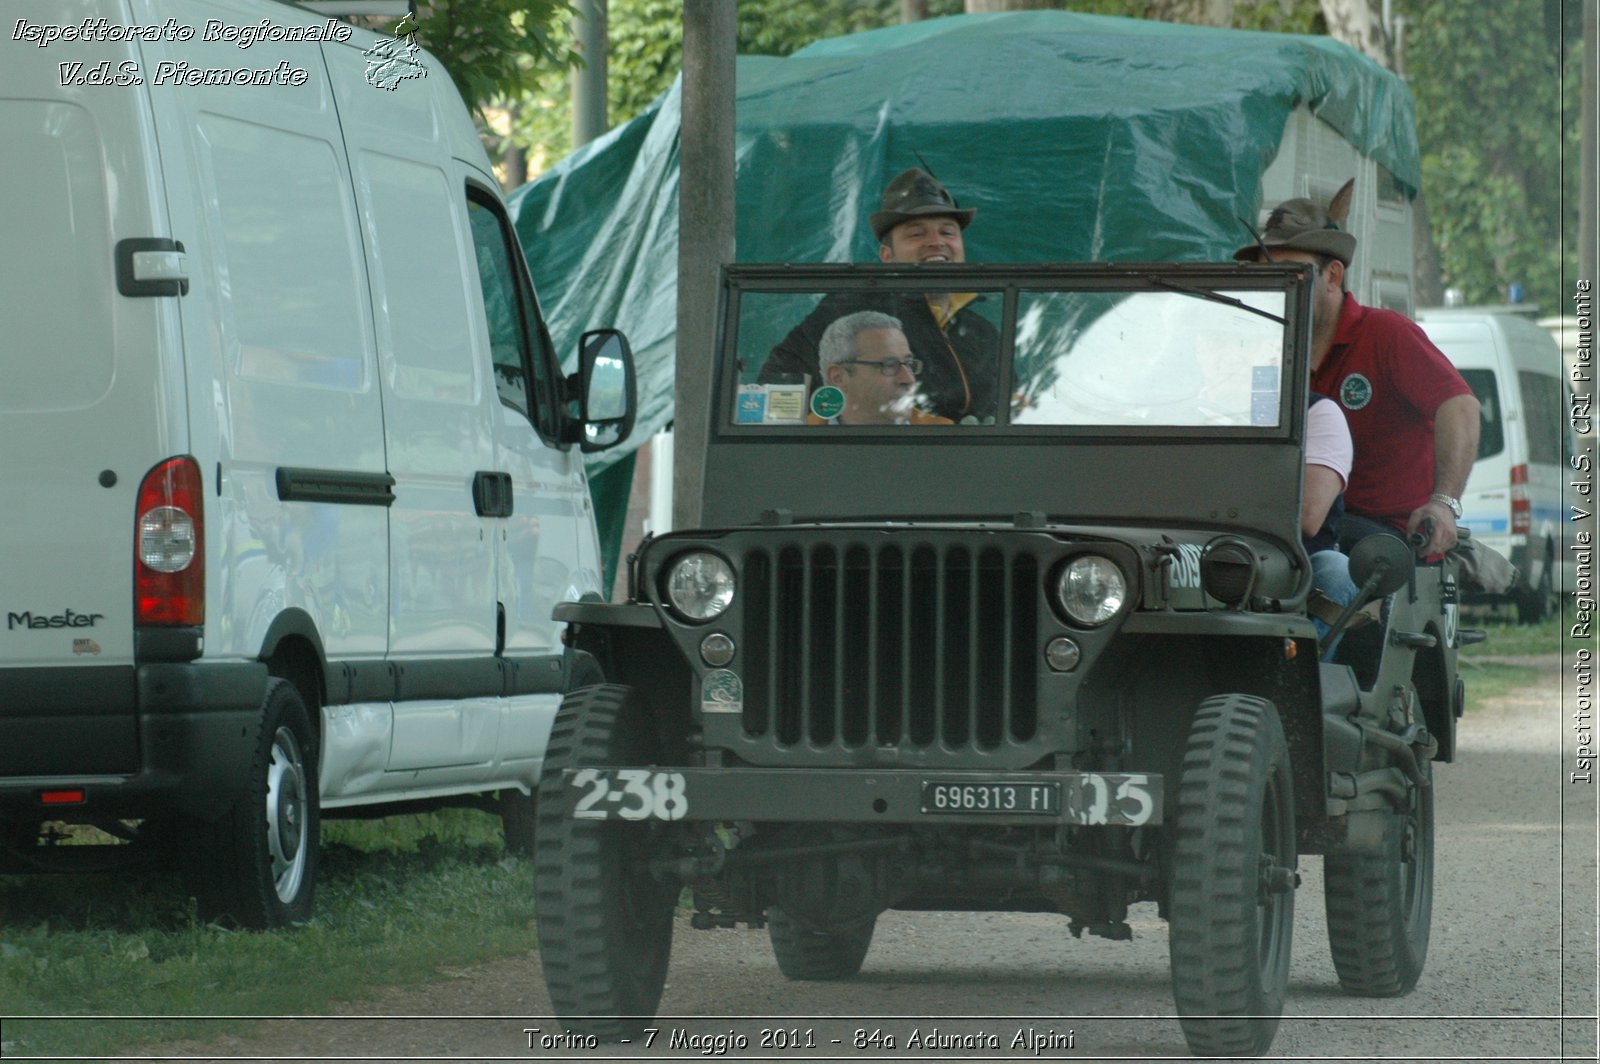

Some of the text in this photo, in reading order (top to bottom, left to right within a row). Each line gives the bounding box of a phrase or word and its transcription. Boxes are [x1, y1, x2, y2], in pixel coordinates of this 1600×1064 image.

[7, 608, 104, 630] Master
[571, 768, 688, 821] 2-38
[935, 786, 1049, 810] 696313 FI
